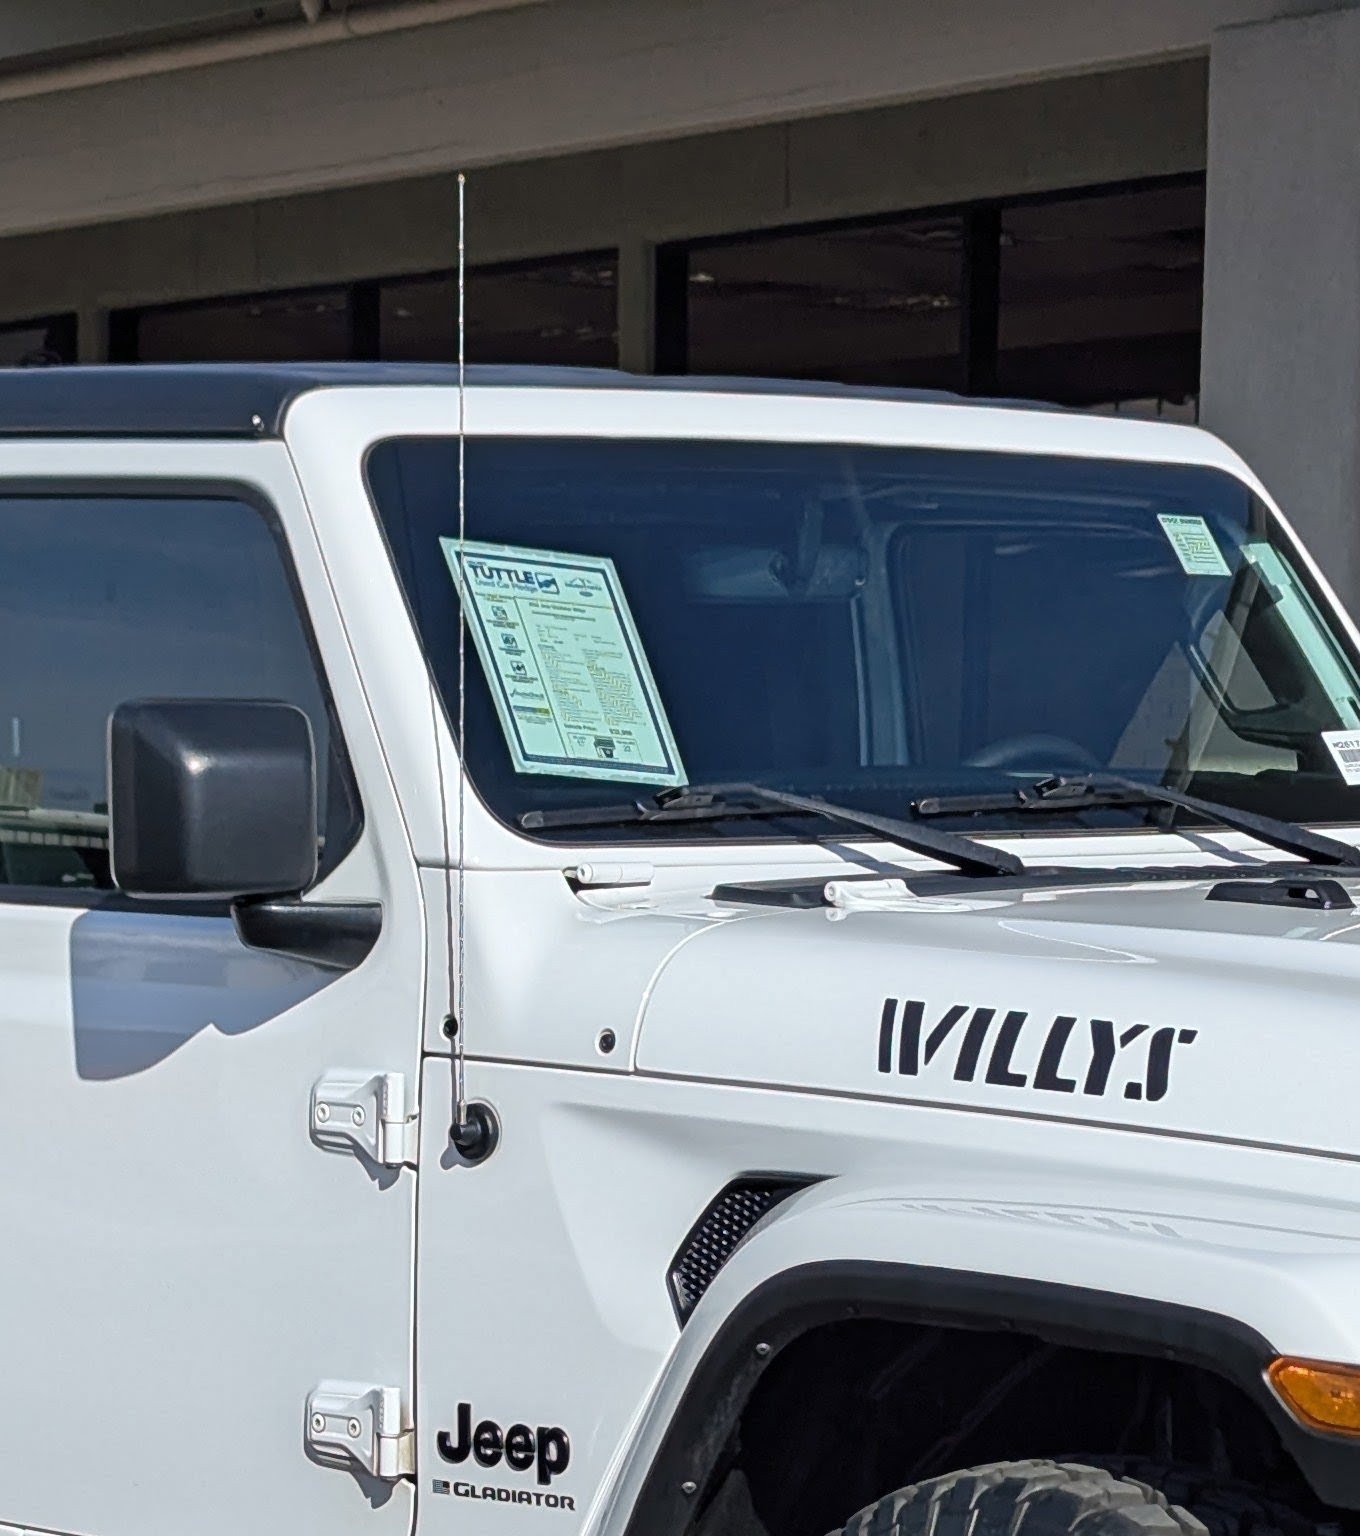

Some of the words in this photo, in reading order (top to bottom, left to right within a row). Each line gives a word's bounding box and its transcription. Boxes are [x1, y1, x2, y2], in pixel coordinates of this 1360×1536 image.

[468, 563, 535, 584] TUTTLE
[878, 998, 1198, 1102] WILLYS
[437, 1402, 570, 1485] Jeep
[453, 1481, 576, 1511] GLADIATOR
